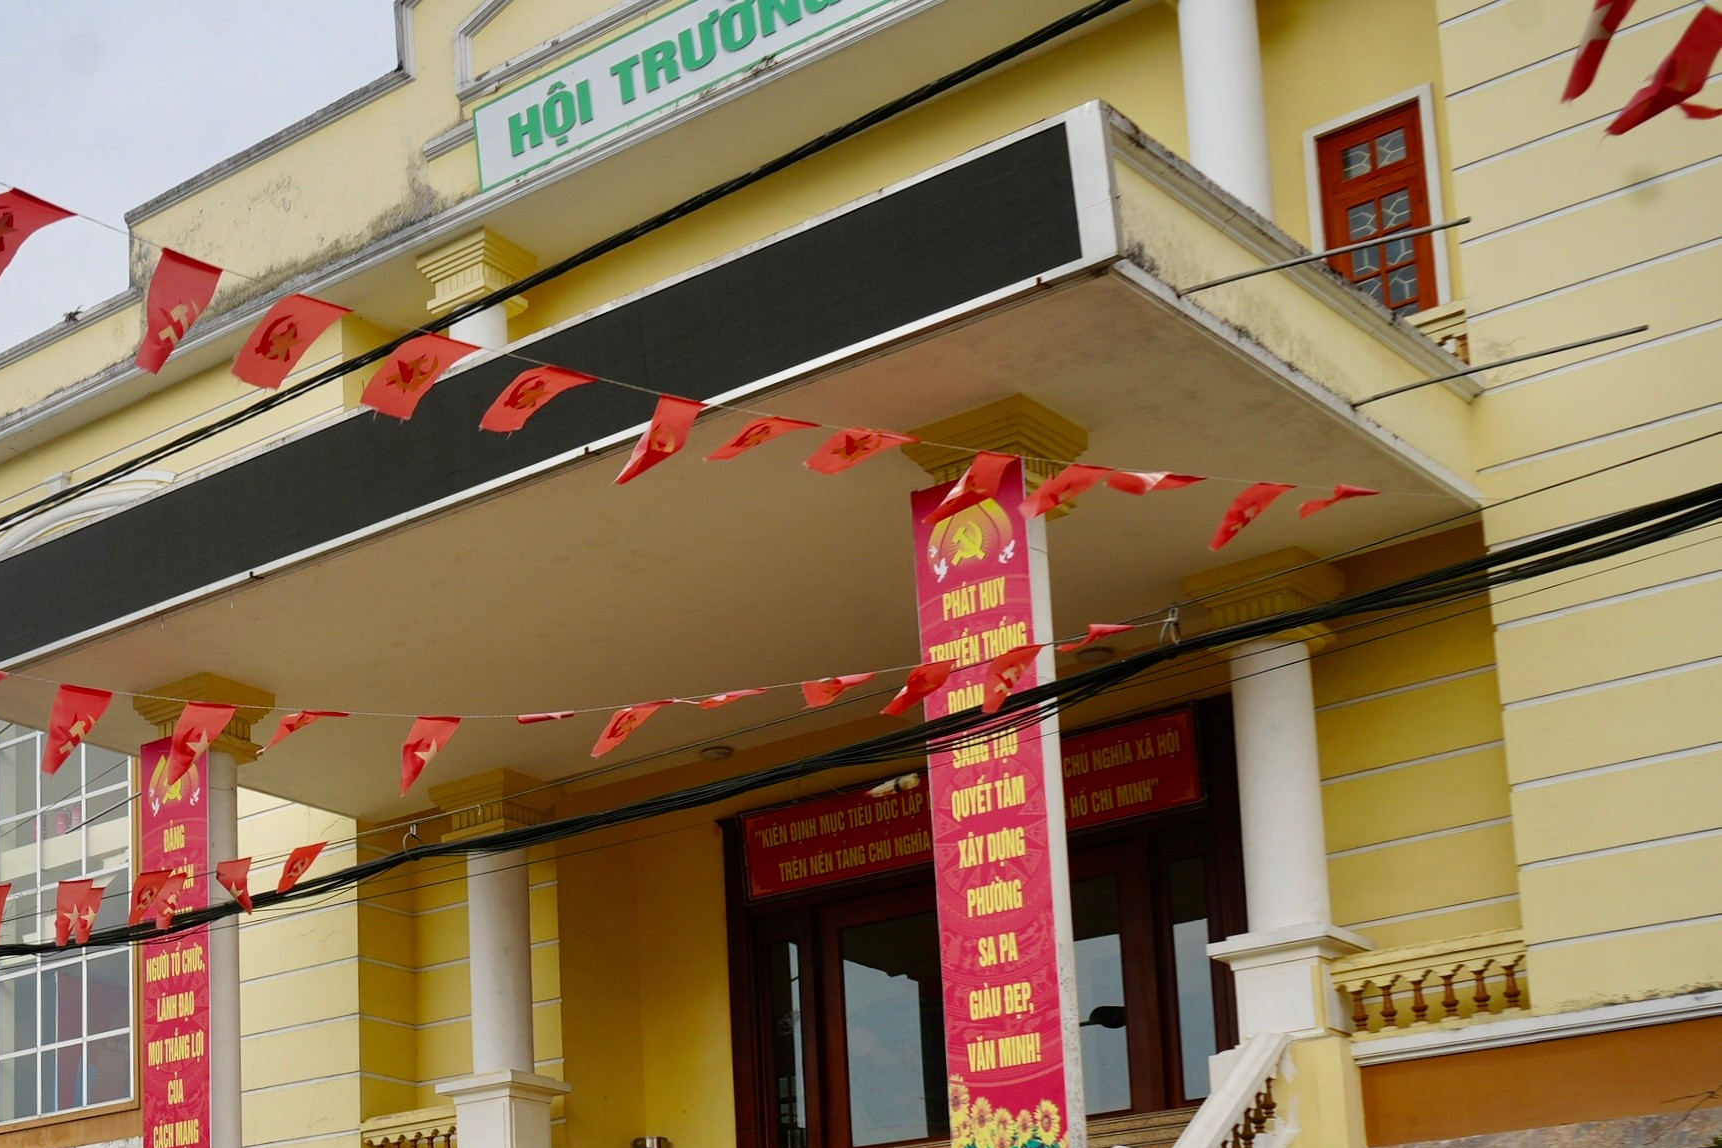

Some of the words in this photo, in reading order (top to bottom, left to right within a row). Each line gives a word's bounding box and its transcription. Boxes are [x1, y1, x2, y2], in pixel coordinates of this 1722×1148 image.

[508, 79, 594, 158] HỘI
[942, 580, 977, 621] PHÁT
[980, 576, 1006, 611] HUY
[929, 627, 980, 669] TRUYỀN
[982, 615, 1027, 660] THỐNG
[952, 731, 989, 769] SÁNG
[991, 727, 1018, 764] TẠO
[1063, 744, 1089, 778] CHỦ
[1092, 740, 1133, 771] NGHĨA
[1135, 733, 1155, 761] XÃ
[1157, 728, 1181, 758] HỘI
[790, 819, 817, 845] ĐỊNH
[819, 811, 845, 837] MỤC
[847, 802, 873, 828] TIÊU
[875, 796, 899, 825] ĐỘC
[901, 789, 923, 820] LẬP
[951, 774, 994, 821] QUYẾT
[995, 772, 1026, 810] TÂM
[1070, 787, 1089, 818] HỒ
[1091, 784, 1114, 813] CHÍ
[163, 819, 185, 853] ĐẢNG
[779, 856, 807, 882] TRÊN
[810, 846, 834, 876] NỀN
[835, 840, 866, 870] TẢNG
[868, 830, 891, 863] CHỦ
[894, 827, 931, 857] NGHĨA
[958, 830, 986, 869] XÂY
[987, 827, 1026, 868] DỰNG
[967, 875, 1023, 918] PHƯỜNG
[146, 948, 169, 983] NGƯỜI
[170, 940, 181, 976] TỔ
[182, 941, 205, 973] CHỨC,
[978, 933, 997, 967] SA
[999, 931, 1019, 964] PA
[156, 990, 177, 1022] LÃNH
[178, 990, 195, 1022] ĐẠO
[969, 982, 1002, 1021] GIÀU
[1003, 980, 1035, 1020] ĐẸP,
[148, 1040, 162, 1071] MỌI
[164, 1027, 190, 1063] THẮNG
[191, 1029, 204, 1063] LỢI
[967, 1034, 996, 1073] VĂN
[999, 1032, 1041, 1066] MINH!
[167, 1072, 184, 1105] CỦA
